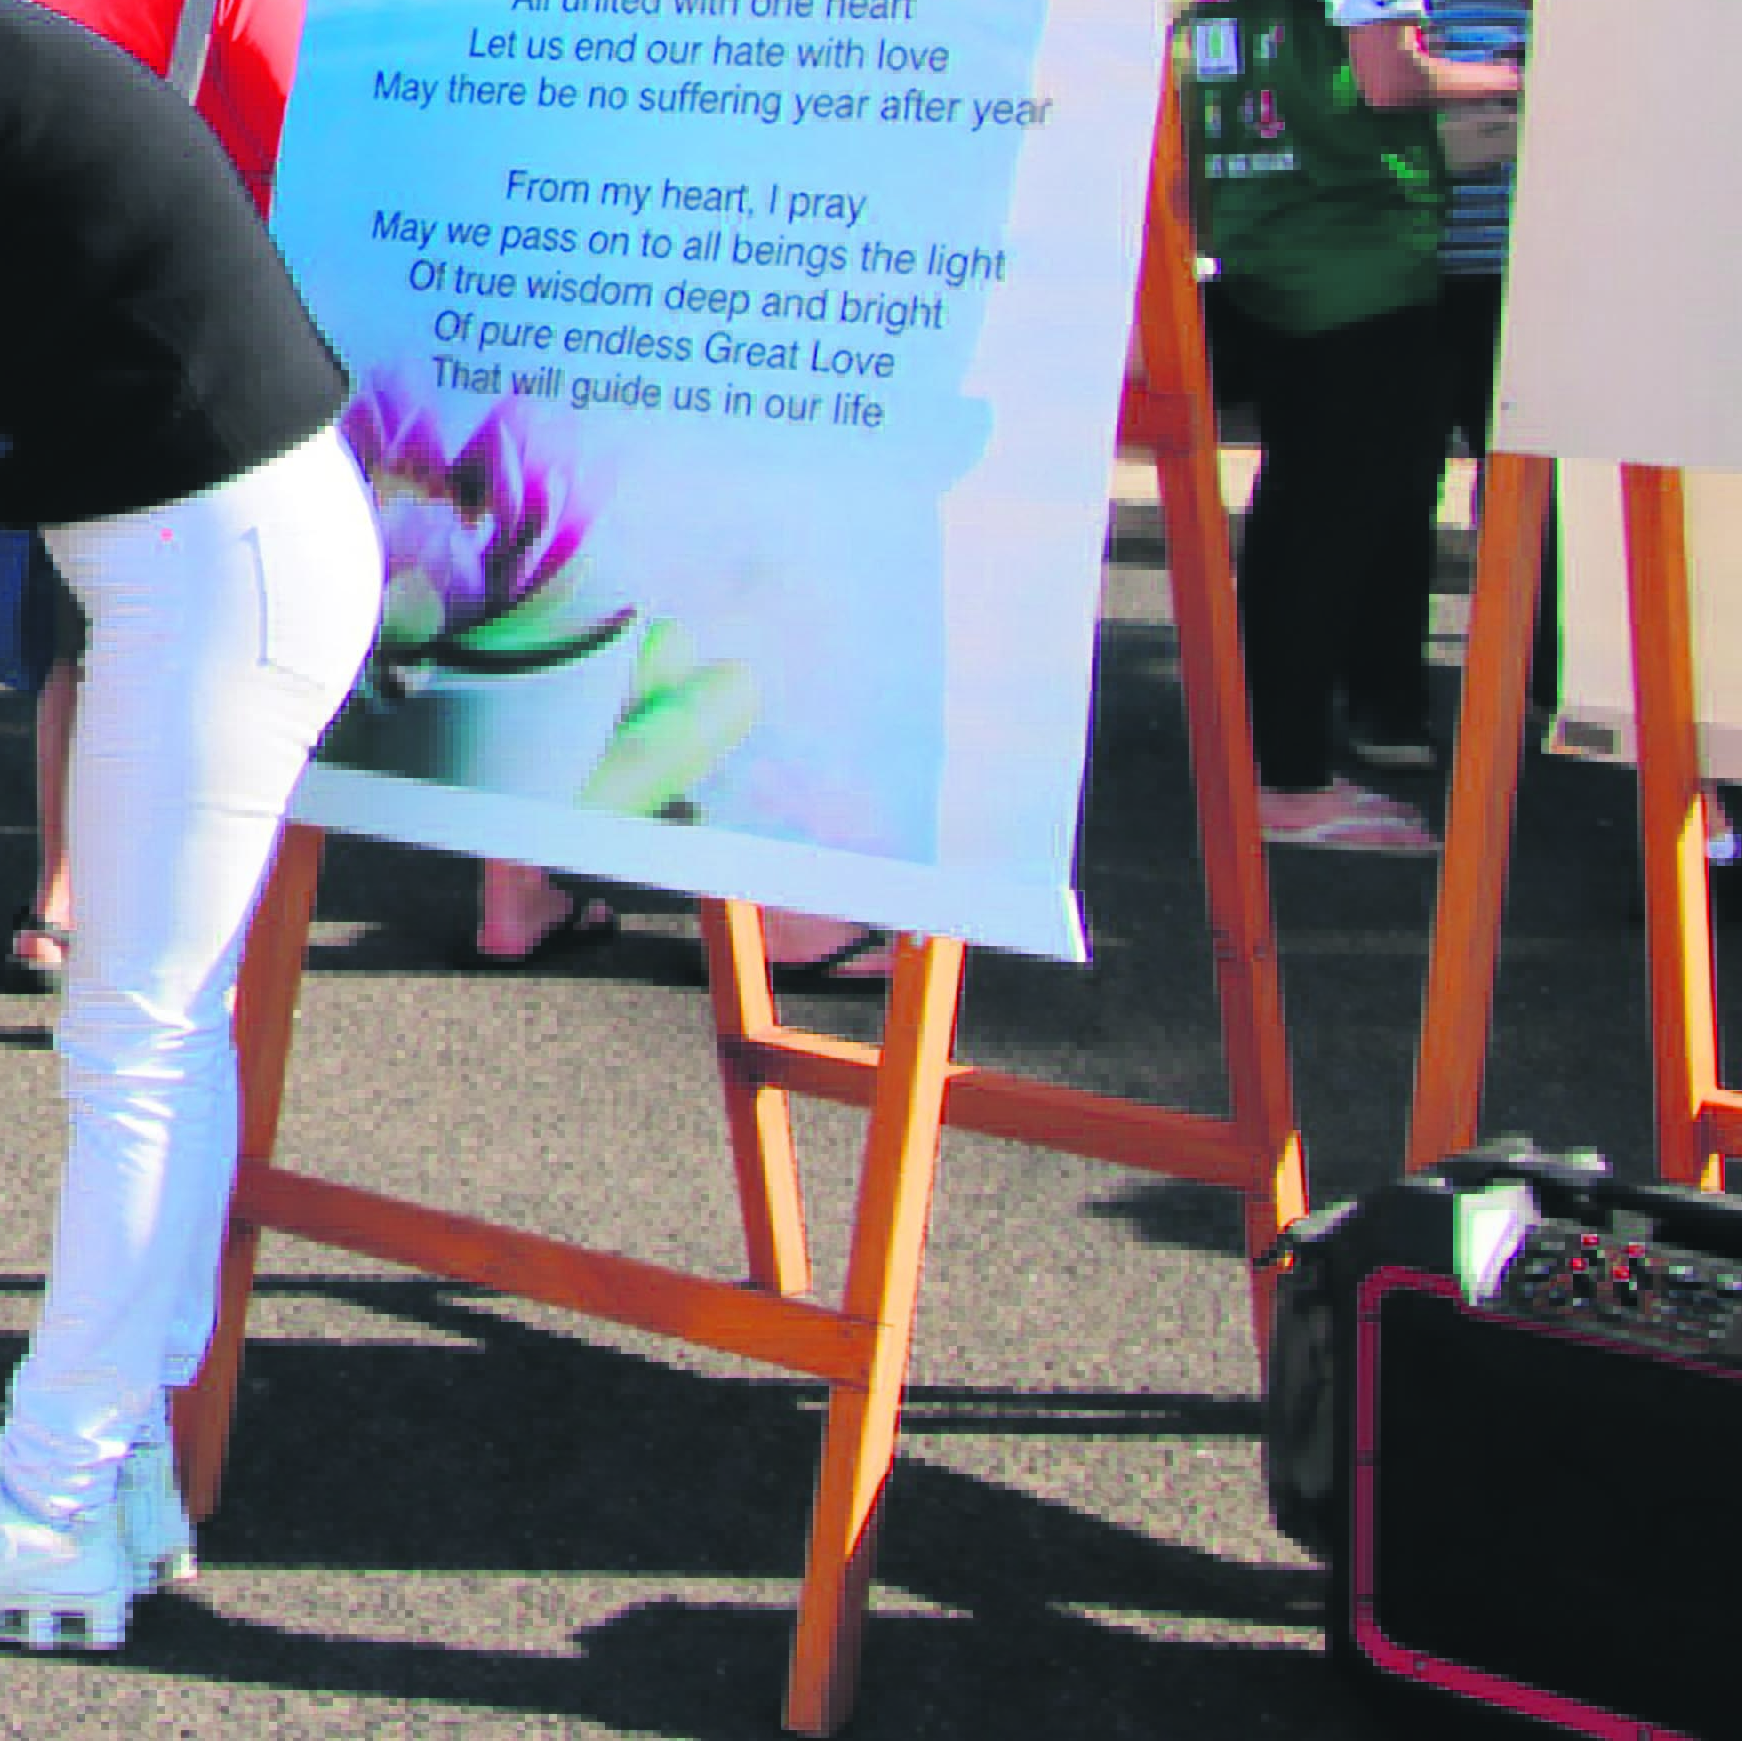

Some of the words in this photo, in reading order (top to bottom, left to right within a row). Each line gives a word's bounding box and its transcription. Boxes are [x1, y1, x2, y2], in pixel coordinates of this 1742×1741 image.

[469, 27, 517, 59] Let
[527, 36, 565, 61] us
[575, 32, 637, 63] end
[647, 39, 703, 66] our
[713, 34, 785, 68] hate
[798, 37, 864, 69] with
[878, 38, 949, 74] love
[373, 70, 439, 110] May
[448, 74, 527, 107] there
[538, 75, 577, 108] be
[588, 85, 629, 111] no
[639, 80, 781, 125] suffering
[792, 93, 870, 126] year
[880, 87, 962, 123] after
[971, 97, 1053, 132] year
[506, 169, 589, 204] From
[601, 182, 652, 216] my
[662, 177, 753, 218] heart,
[769, 183, 780, 215] I
[788, 191, 867, 228] pray
[372, 210, 438, 251] May
[448, 222, 492, 248] we
[500, 225, 577, 257] pass
[589, 230, 629, 256] on
[642, 228, 672, 259] to
[683, 230, 721, 261] all
[732, 233, 847, 277] beings
[861, 241, 916, 275] the
[928, 243, 1005, 286] light
[409, 258, 447, 291] Of
[455, 265, 517, 299] true
[527, 269, 653, 308] wisdom
[664, 279, 750, 322] deep
[761, 288, 829, 322] and
[839, 290, 943, 334] bright
[434, 309, 474, 343] Of
[478, 321, 555, 353] pure
[564, 325, 693, 363] endless
[705, 329, 800, 371] Great
[811, 339, 894, 378] Love
[432, 355, 501, 395] That
[512, 365, 565, 398] will
[571, 373, 661, 411] guide
[674, 386, 711, 413] us
[725, 382, 753, 417] in
[765, 394, 822, 422] our
[834, 392, 885, 428] life
